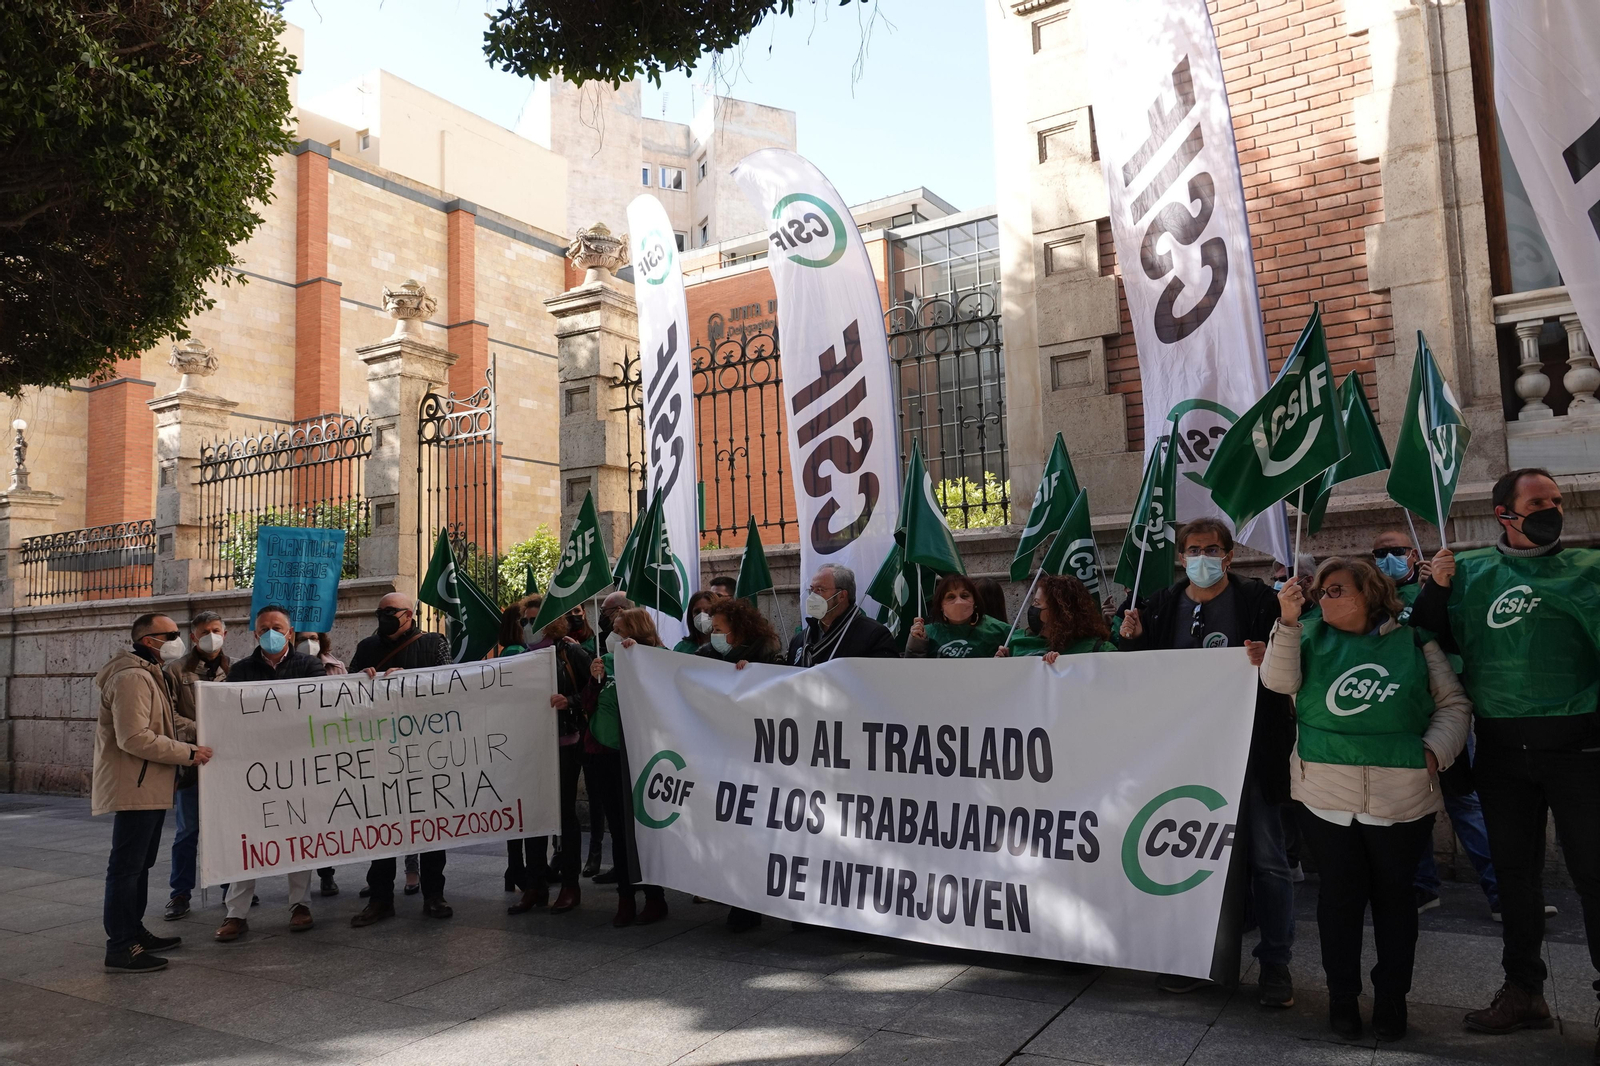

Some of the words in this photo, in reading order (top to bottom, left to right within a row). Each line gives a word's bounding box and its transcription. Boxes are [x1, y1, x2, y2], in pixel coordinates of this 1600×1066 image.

[727, 303, 762, 322] JUNTA
[1271, 361, 1327, 447] CSIF
[268, 559, 328, 579] ALBERGUE
[268, 602, 322, 622] MERIA
[240, 688, 281, 714] LA
[297, 669, 467, 709] PLANTILLA
[480, 660, 513, 690] DE
[308, 710, 462, 748] Inturjoven
[754, 718, 799, 767] NO
[810, 720, 851, 770] AL
[862, 722, 1054, 784] TRASLADO
[246, 748, 375, 792] QUIERE
[388, 733, 512, 775] SEGUIR
[647, 772, 695, 808] CSIF
[263, 798, 306, 828] EN
[328, 770, 503, 825] ALMERIA
[715, 780, 759, 827] DE
[766, 788, 826, 835] LOS
[836, 793, 1101, 863] TRABAJADORES
[241, 834, 280, 870] ¡NO
[286, 822, 403, 861] TRASLADOS
[411, 798, 523, 844] FORZOSOS!
[1145, 818, 1237, 861] CSIF
[767, 853, 808, 903] DE
[819, 859, 1031, 934] INTURJOVEN
